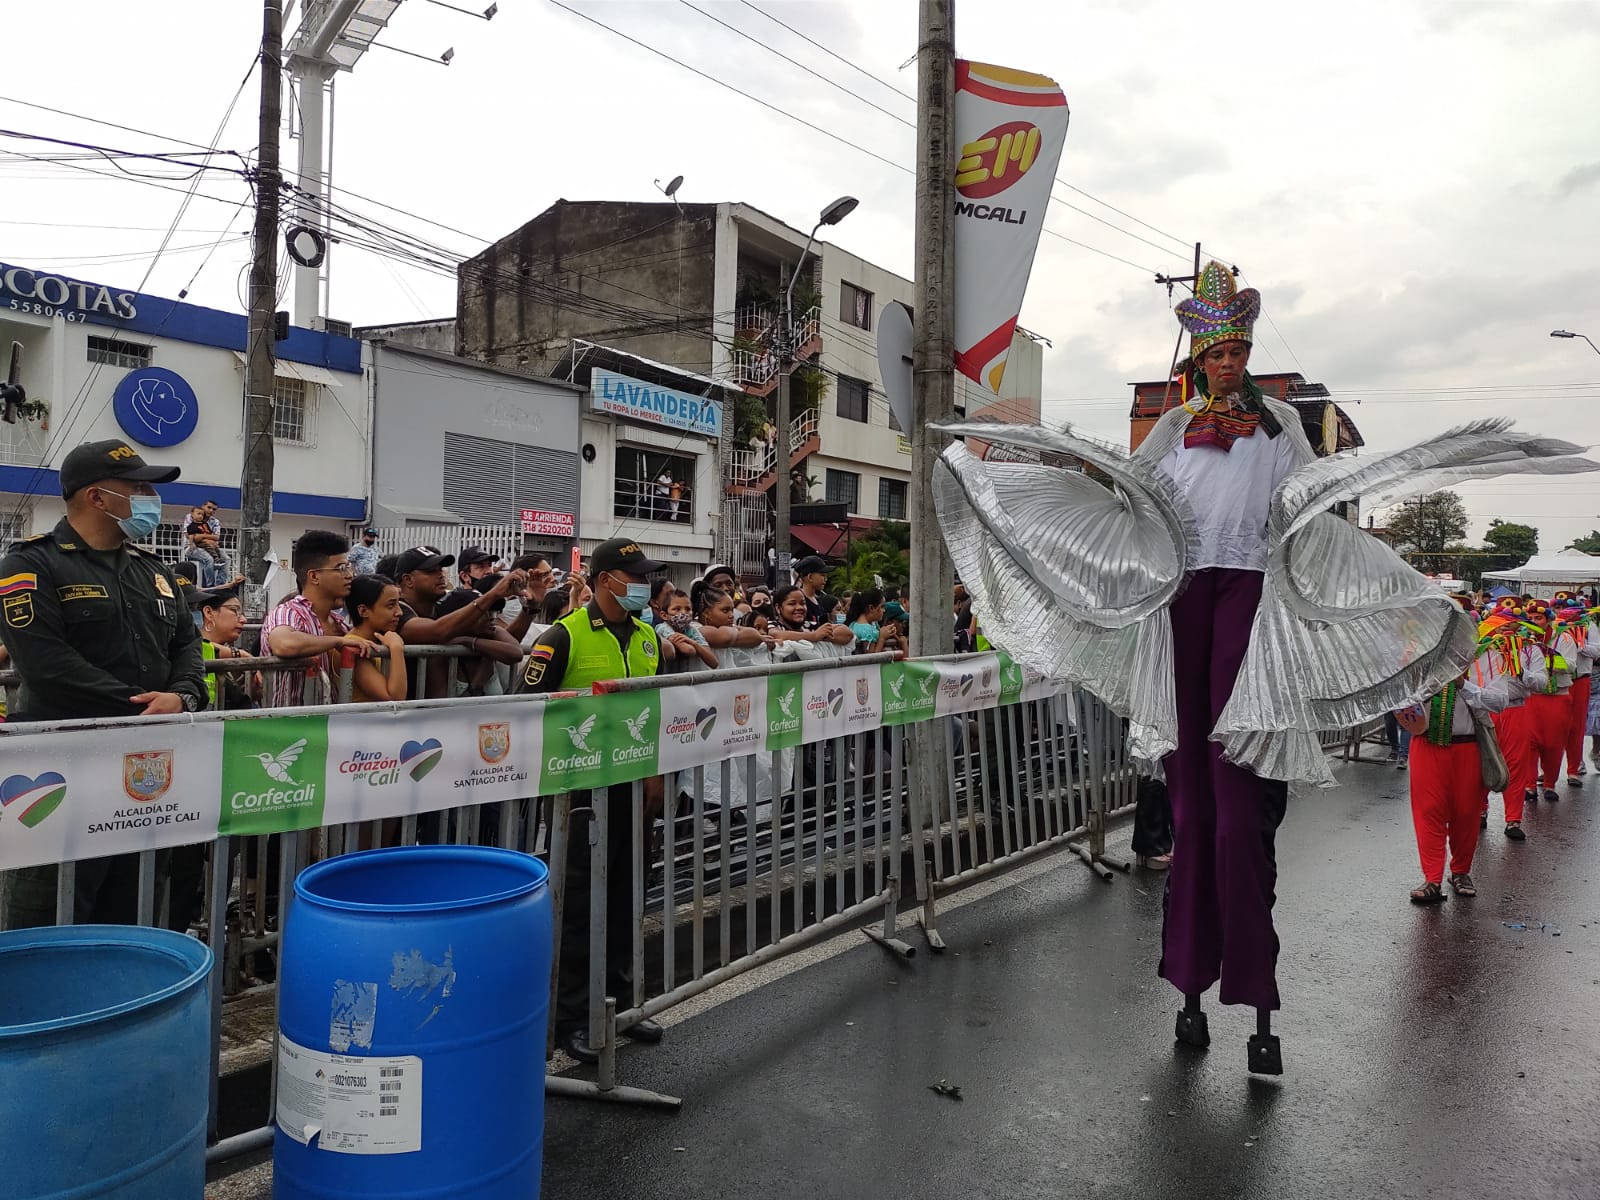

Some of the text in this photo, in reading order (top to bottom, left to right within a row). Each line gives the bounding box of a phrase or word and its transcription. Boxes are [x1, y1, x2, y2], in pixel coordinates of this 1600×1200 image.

[954, 201, 1027, 225] MCALI
[0, 264, 137, 320] COTAS
[10, 299, 87, 325] 5580667
[603, 377, 716, 426] LAVANDERÍA
[612, 403, 630, 415] ROPA
[630, 407, 639, 416] LO
[523, 511, 573, 525] SE ARRIENDA
[538, 524, 572, 536] 2520200
[770, 717, 800, 732] Corfecali
[680, 730, 697, 744] Cali
[352, 750, 383, 761] Puro
[547, 750, 602, 771] Corfecali
[612, 742, 655, 762] Corfecali
[339, 756, 398, 774] Corazón
[353, 768, 401, 786] por Cali
[454, 772, 528, 788] SANTIAGO DE CALI
[231, 783, 316, 809] Corfecali
[113, 802, 179, 818] ALCALDÍA DE
[87, 811, 201, 834] SANTIAGO DE CALI
